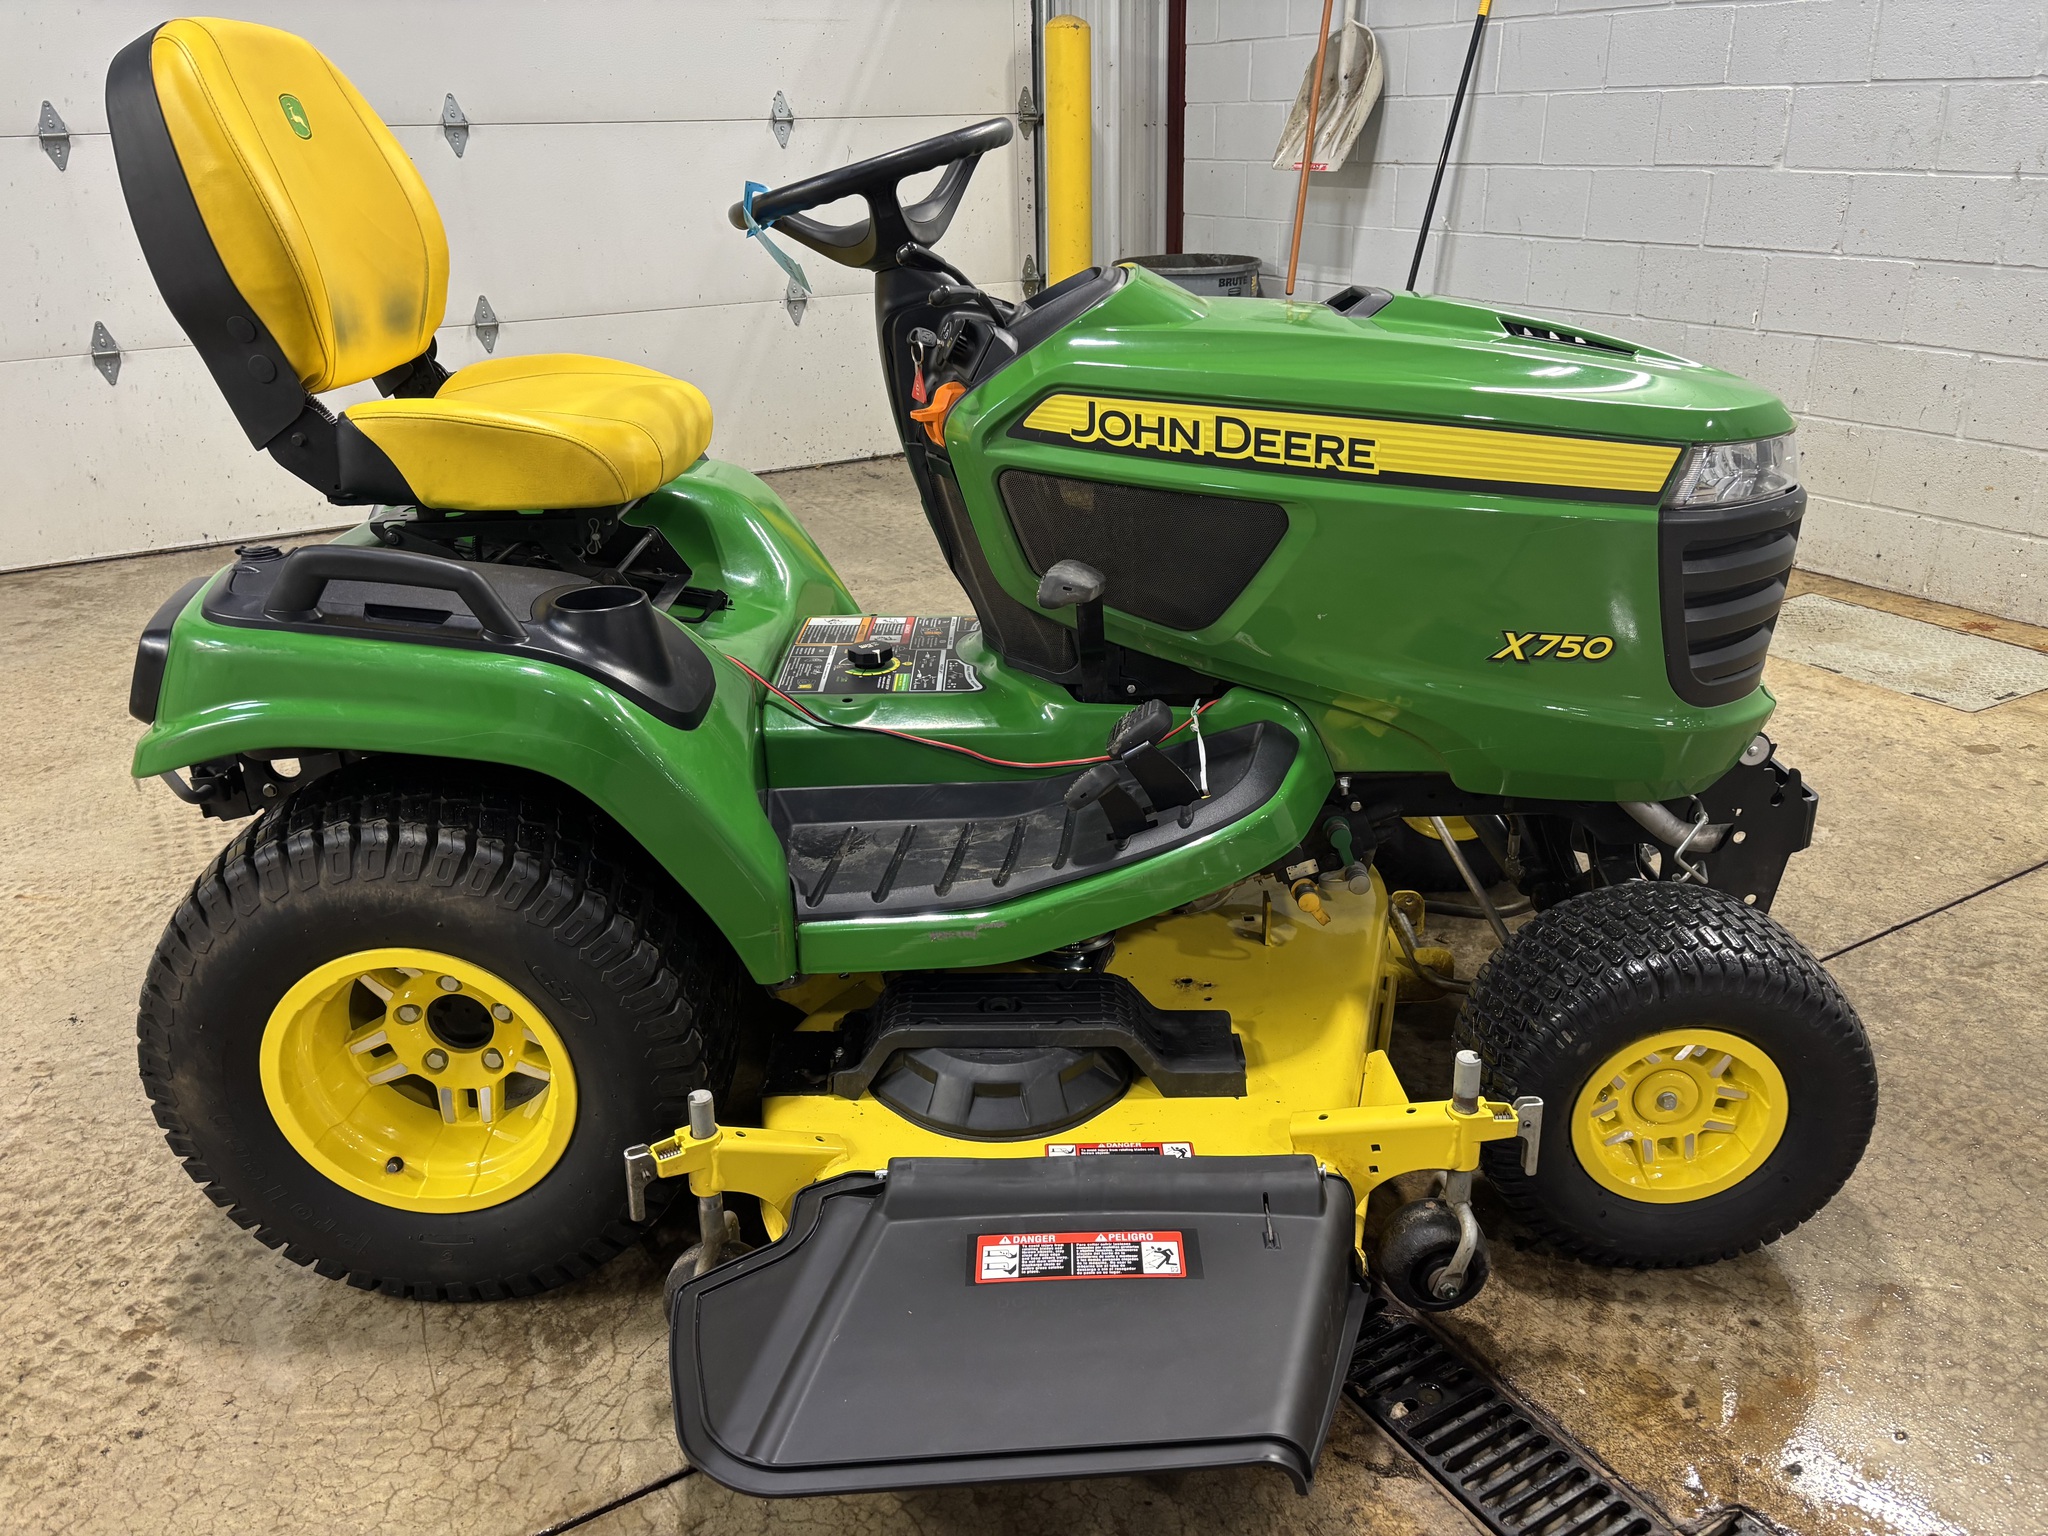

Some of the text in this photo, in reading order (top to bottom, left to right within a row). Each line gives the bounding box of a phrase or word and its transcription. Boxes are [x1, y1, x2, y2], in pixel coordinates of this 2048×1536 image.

[1218, 276, 1248, 287] BRUTE
[1070, 401, 1376, 470] JOHN DEERE
[1489, 631, 1614, 661] X750
[1012, 1235, 1056, 1243] DANGER
[1108, 1233, 1154, 1241] PELIGRO
